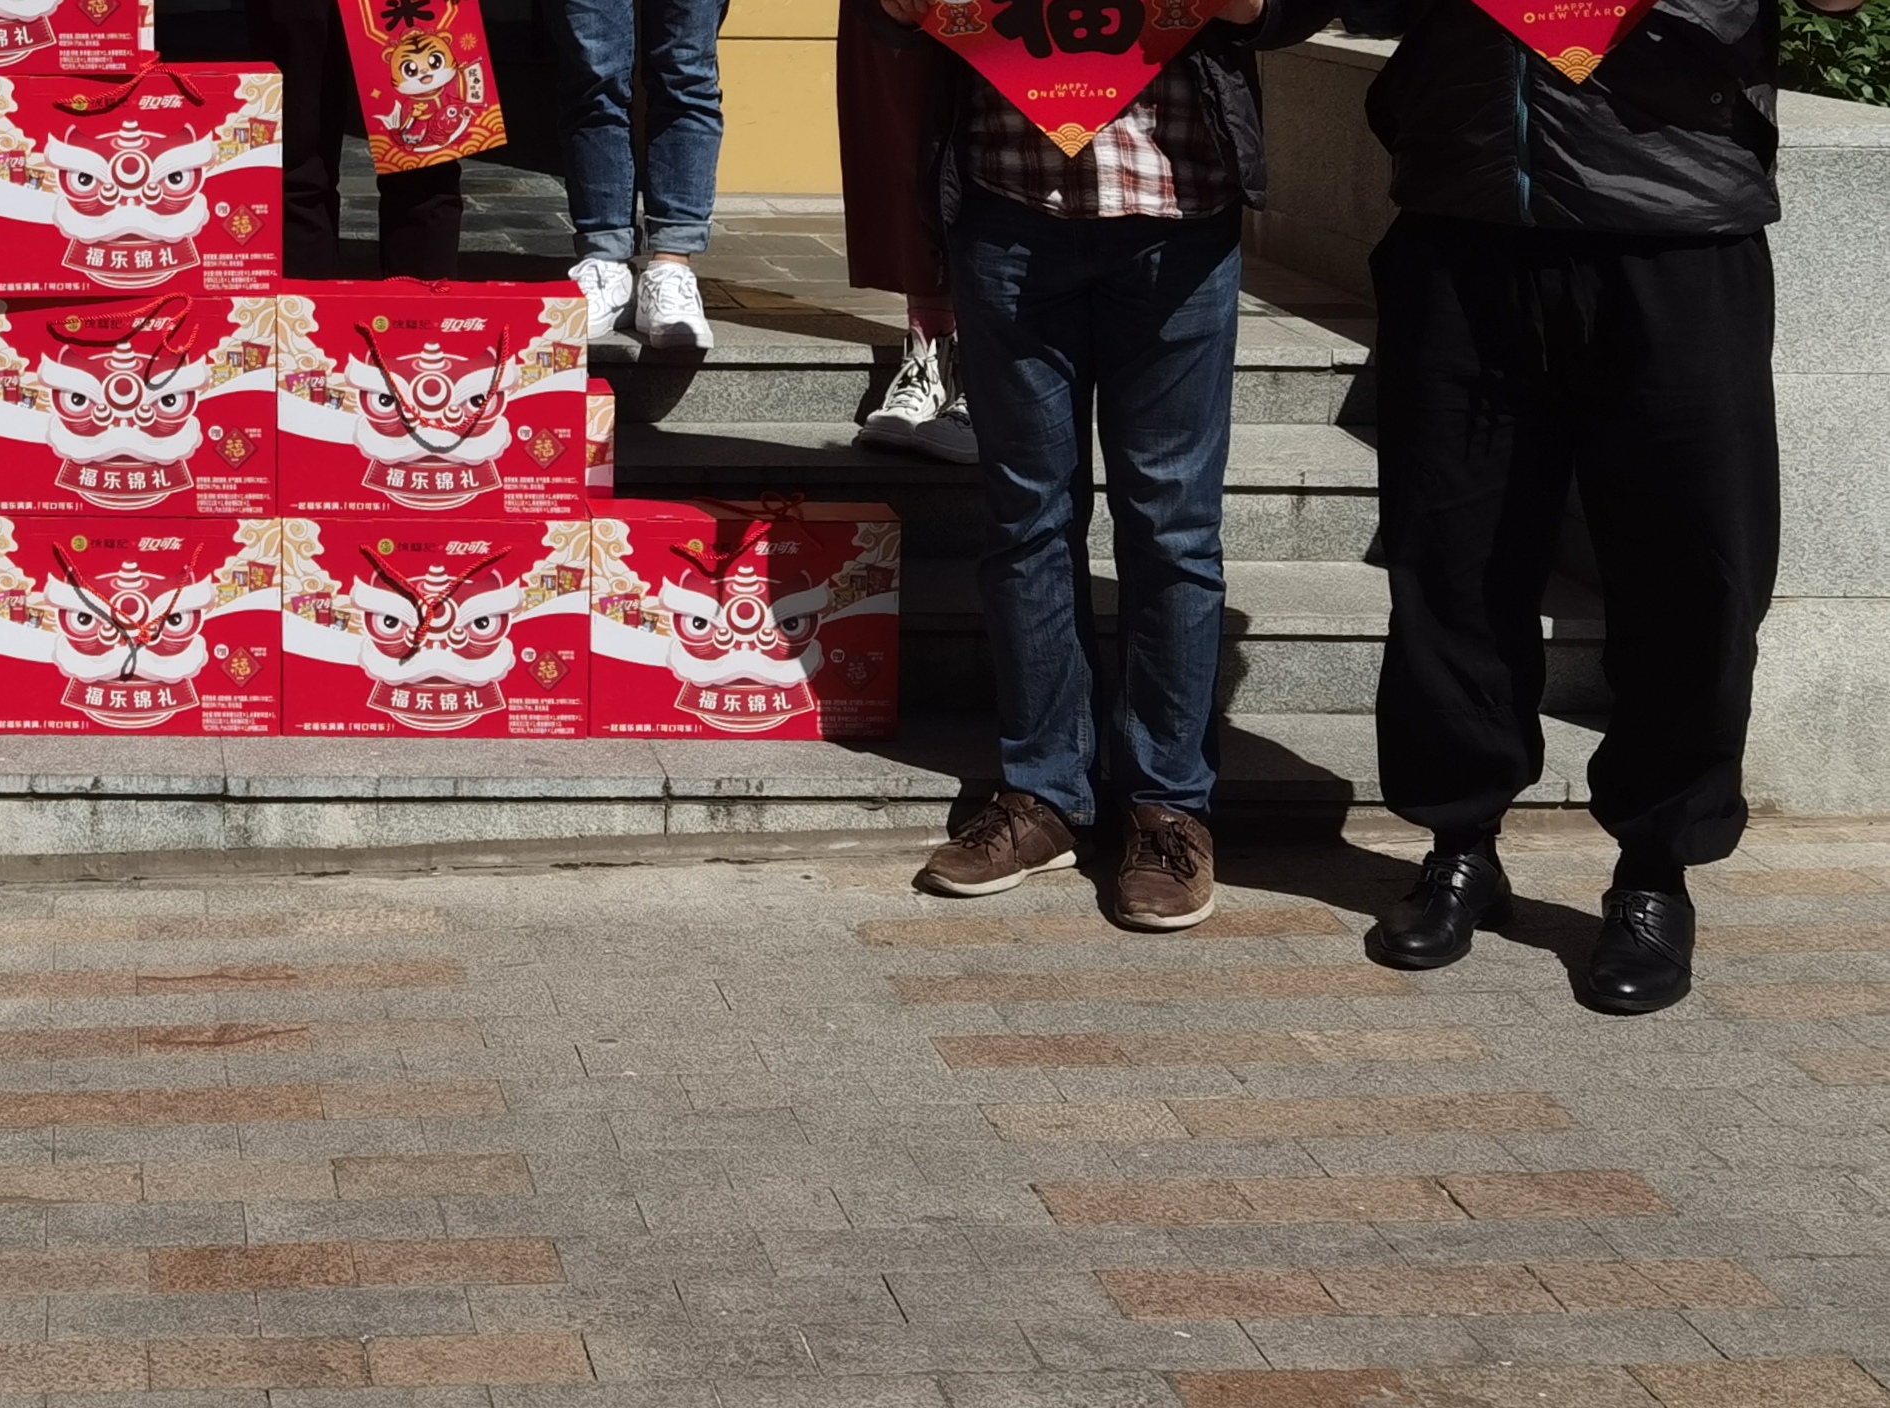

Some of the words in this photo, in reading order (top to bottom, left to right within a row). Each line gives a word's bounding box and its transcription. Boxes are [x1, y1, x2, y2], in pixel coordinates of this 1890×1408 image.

[1537, 10, 1567, 21] NEW
[1573, 8, 1612, 19] YEAR
[1554, 2, 1593, 12] HAPPY
[1040, 89, 1066, 98] NEW
[1070, 88, 1105, 97] YEAR
[1054, 83, 1089, 92] HAPPY
[139, 95, 184, 110] 可口可乐
[86, 248, 178, 268] 福乐锦礼
[441, 317, 487, 332] 可口可乐
[79, 468, 171, 489] 福乐锦礼
[386, 468, 479, 489] 福乐锦礼
[138, 537, 184, 551] 可口可乐
[446, 541, 491, 555] 可口可乐
[85, 686, 177, 708] 福乐锦礼
[391, 691, 483, 712] 福乐锦礼
[699, 691, 792, 713] 福乐锦礼
